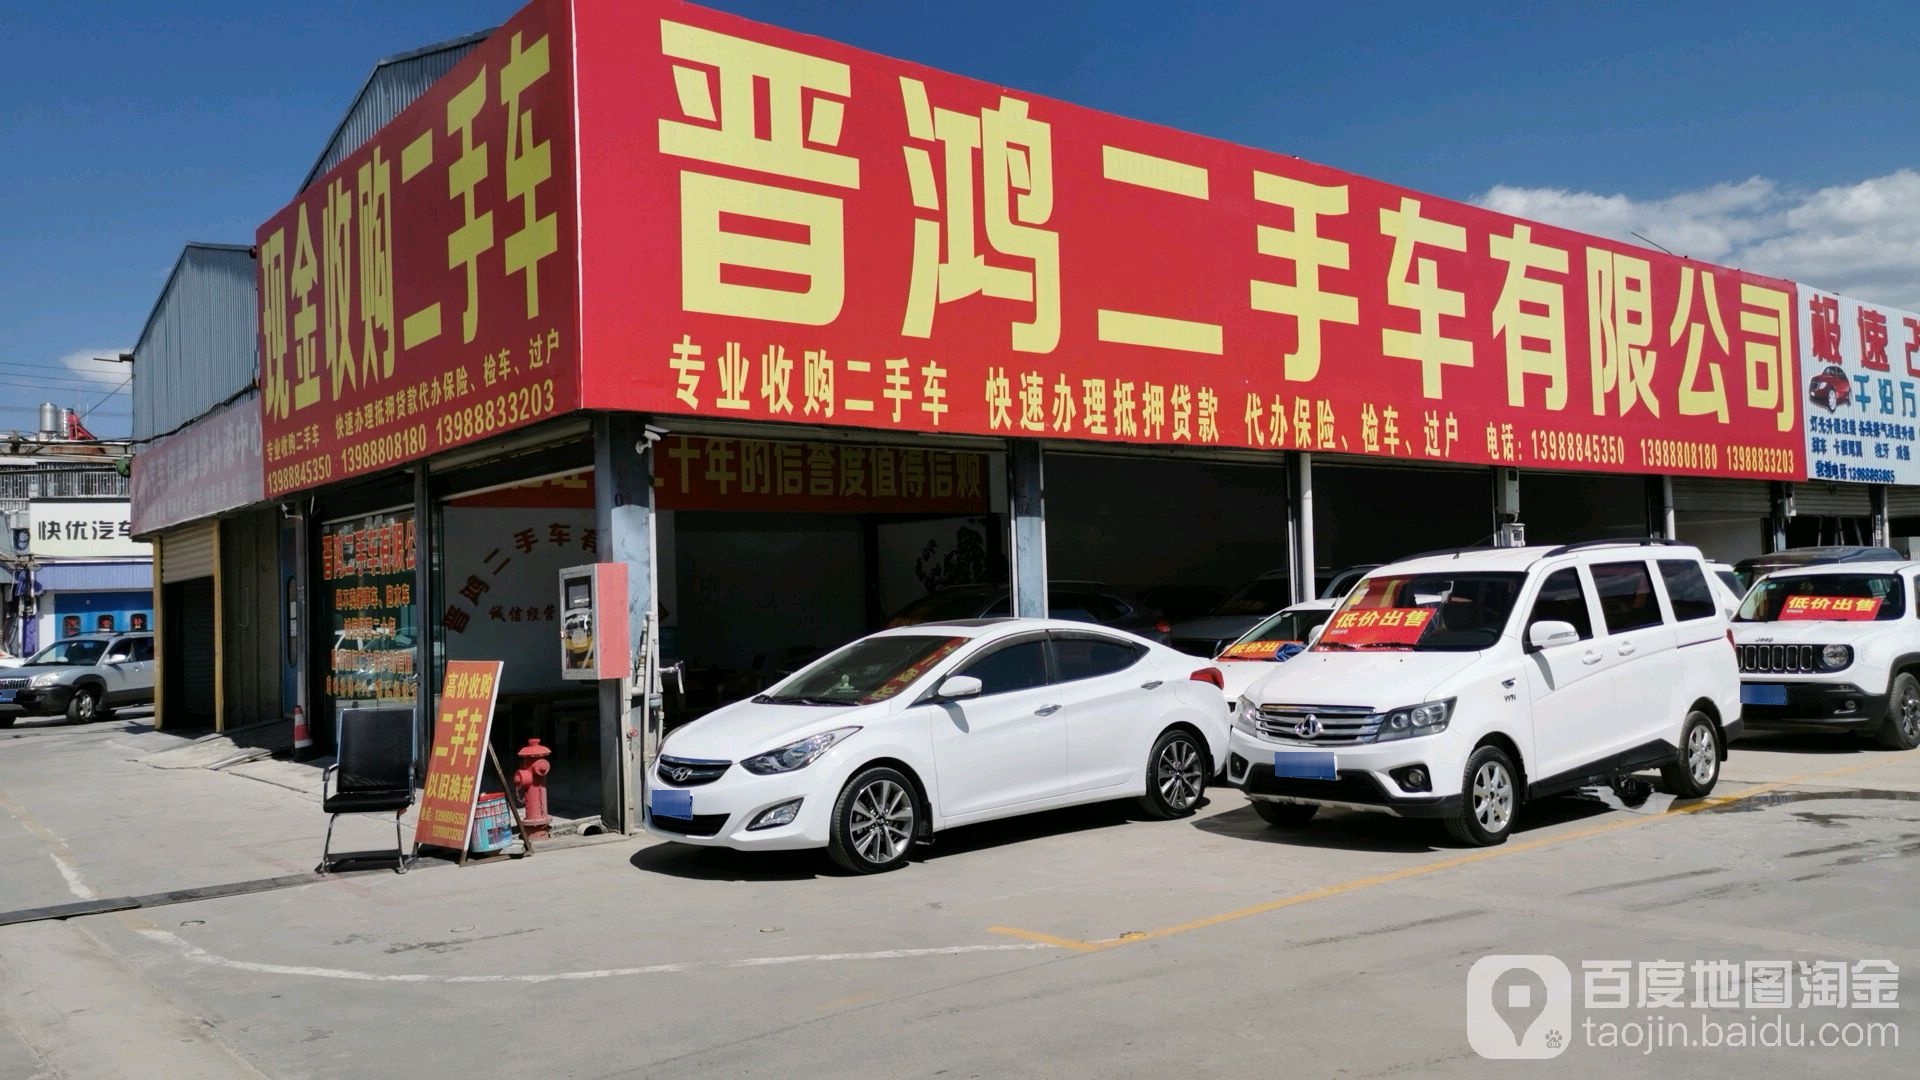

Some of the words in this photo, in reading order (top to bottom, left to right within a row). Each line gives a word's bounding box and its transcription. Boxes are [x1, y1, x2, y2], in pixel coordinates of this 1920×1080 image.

[261, 30, 558, 422] 现金收购二手车
[658, 18, 1795, 432] 晋鸿二手车有限公司
[669, 334, 949, 426] 专业收购二手车
[985, 366, 1220, 443] 快速办理抵押贷款
[1244, 392, 1459, 458] 代办保险、检车、过户
[1531, 430, 1624, 464] 13988845350
[1640, 438, 1718, 473] 13988808180
[1726, 446, 1794, 473] 13988833203
[266, 423, 320, 463] 专业收购二手车
[267, 453, 332, 494] 13988845350
[341, 423, 427, 475] 13988808180
[436, 379, 555, 446] 13988833203
[653, 437, 981, 499] 十年的信誉度值得信赖
[1336, 610, 1429, 629] 低价出售
[1789, 597, 1876, 612] 低价出售
[445, 673, 493, 699] 高价收购
[435, 708, 483, 767] 二手车
[426, 772, 475, 804] 以旧换新
